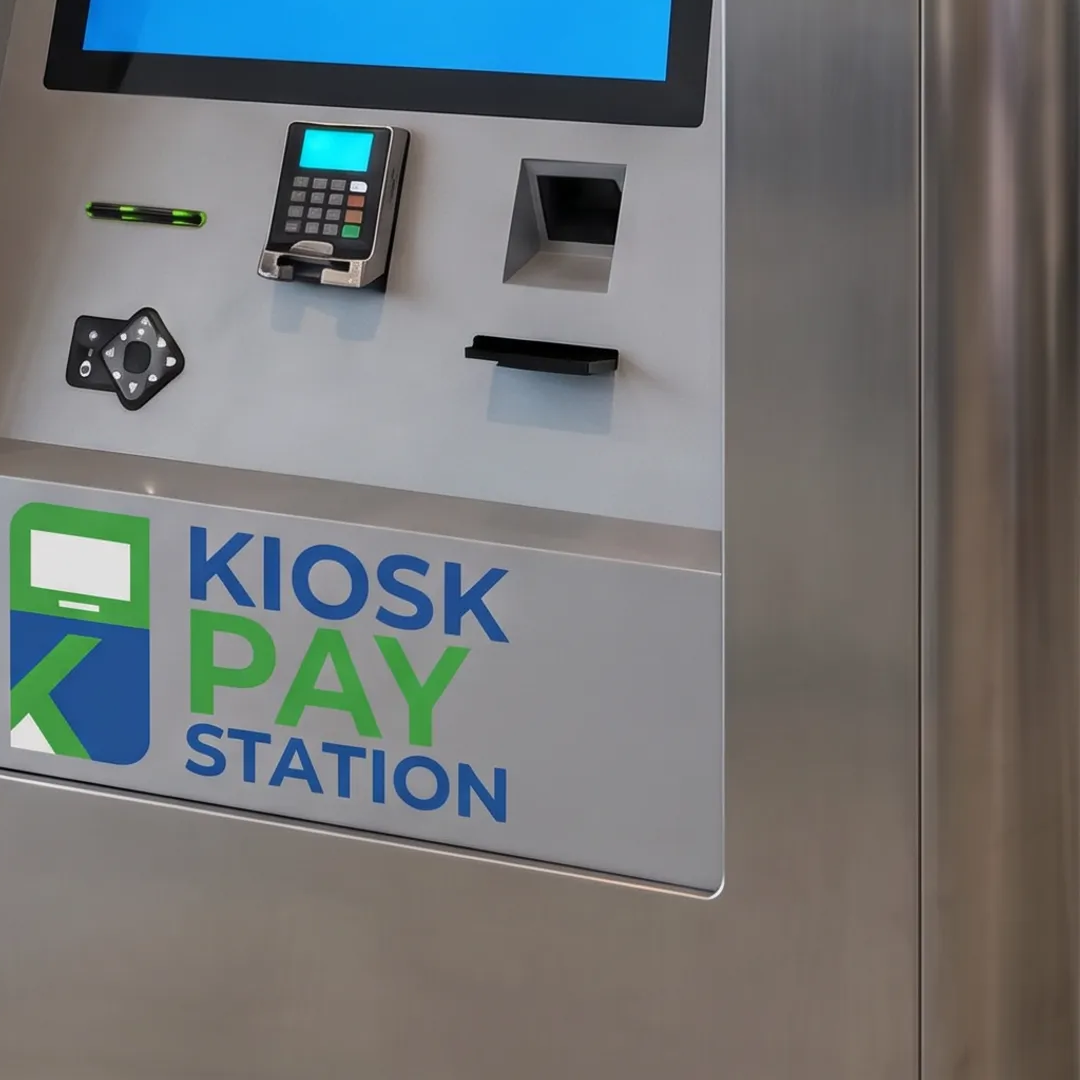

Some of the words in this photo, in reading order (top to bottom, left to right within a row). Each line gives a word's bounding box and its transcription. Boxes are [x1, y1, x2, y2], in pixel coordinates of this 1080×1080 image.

[189, 526, 509, 643] KIOSK
[190, 609, 471, 747] PAY
[185, 722, 508, 823] STATION
